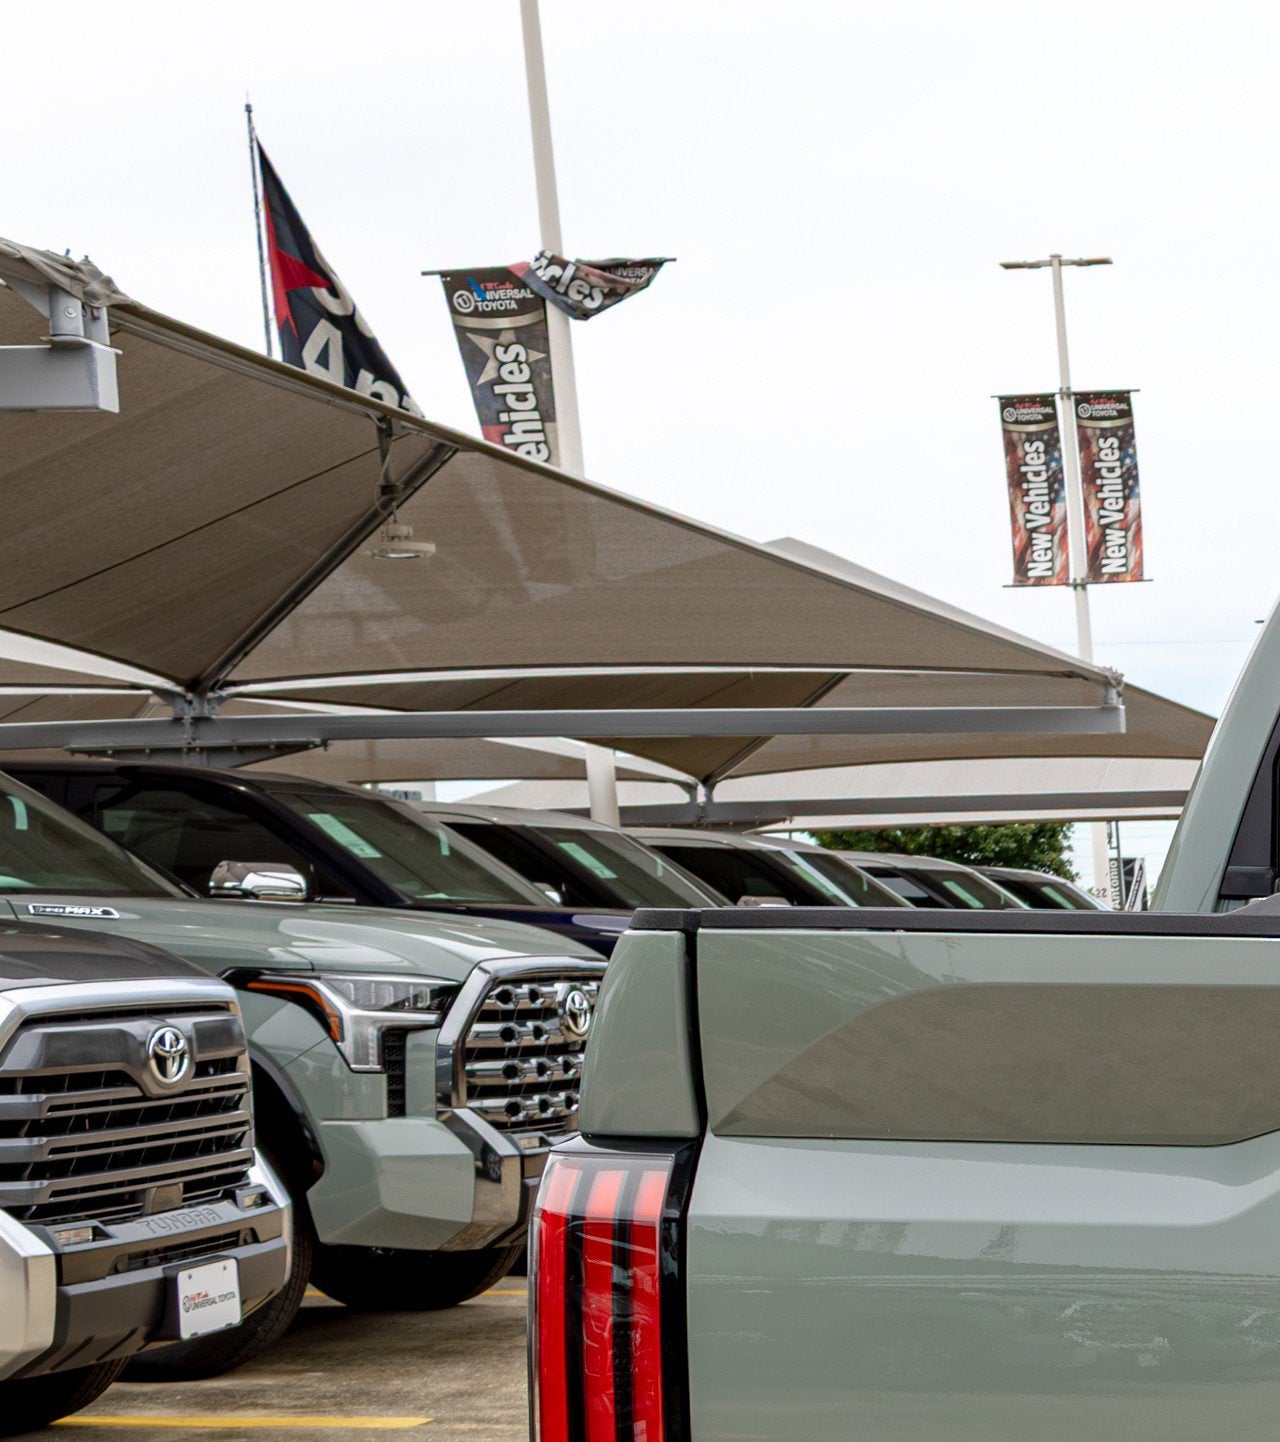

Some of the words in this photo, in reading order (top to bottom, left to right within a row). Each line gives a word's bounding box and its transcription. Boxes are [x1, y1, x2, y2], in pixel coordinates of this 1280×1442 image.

[476, 300, 519, 312] TOYOTA
[1020, 440, 1052, 529] Vehicles
[1094, 437, 1126, 525] Vehicles
[1027, 532, 1053, 577] New
[1101, 528, 1127, 573] New
[136, 1207, 223, 1235] TUNDRA
